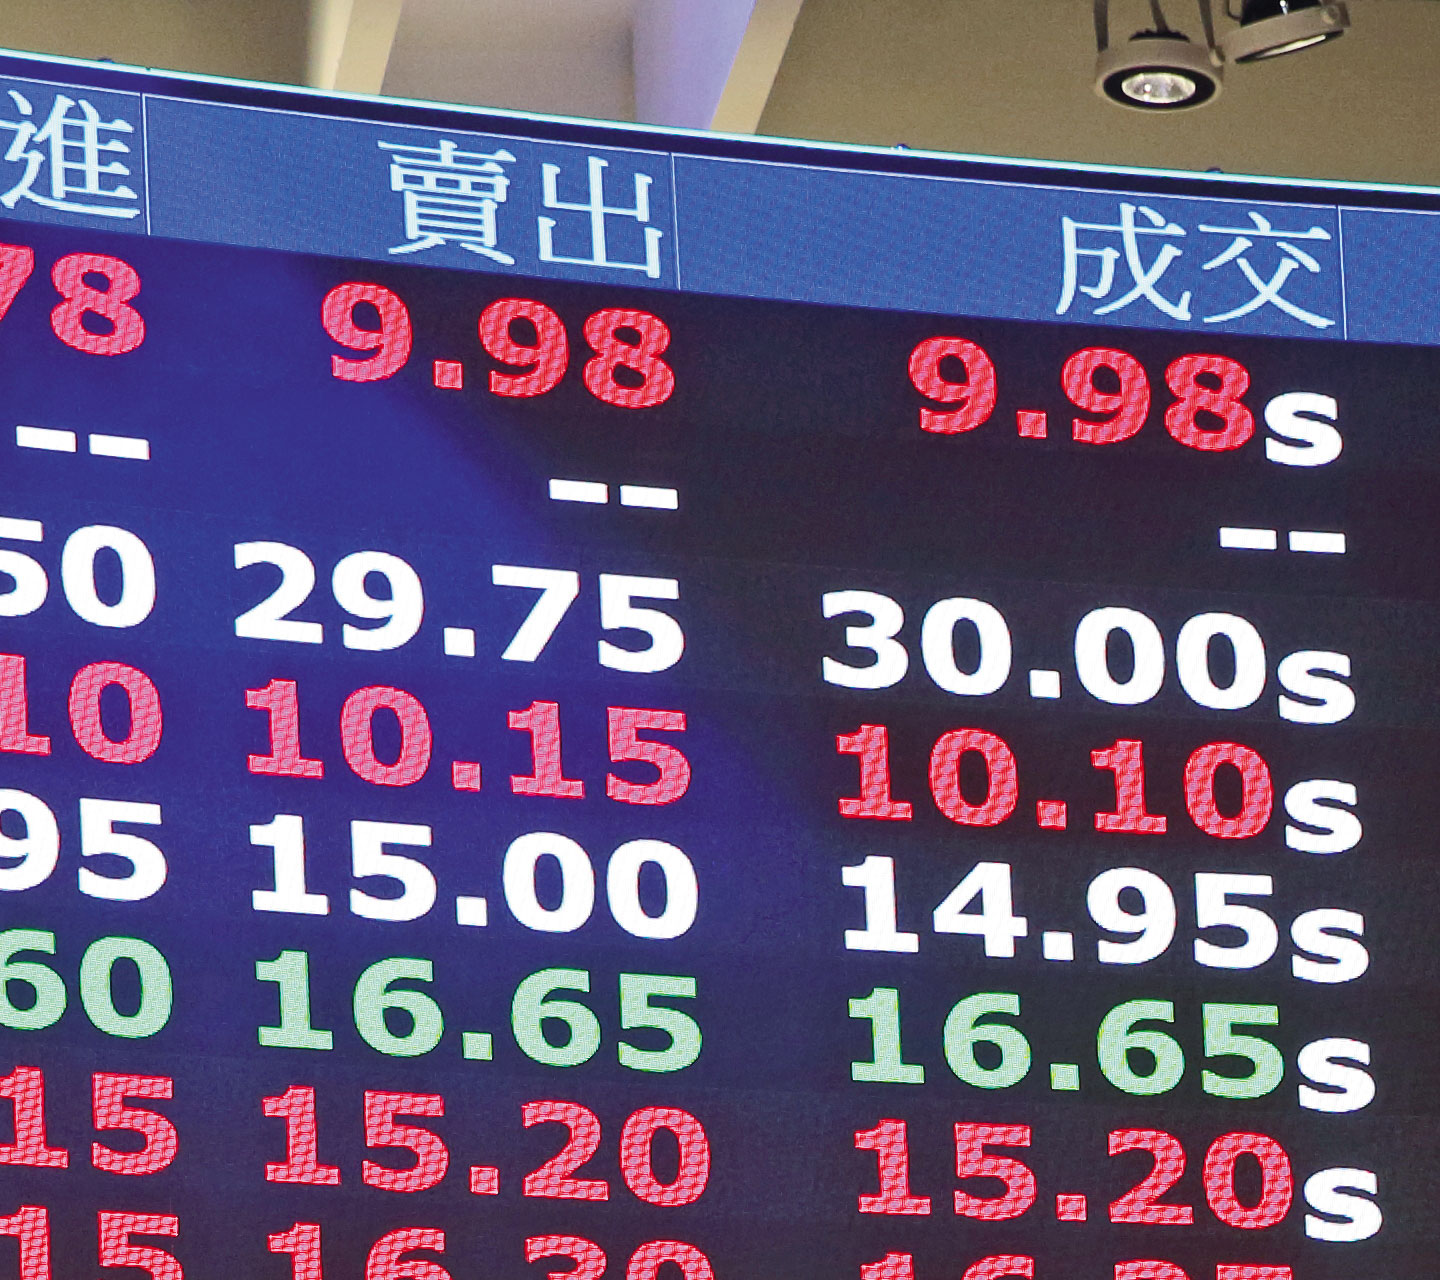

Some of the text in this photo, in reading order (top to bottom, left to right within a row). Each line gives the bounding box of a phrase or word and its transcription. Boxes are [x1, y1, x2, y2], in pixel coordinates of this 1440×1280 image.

[374, 138, 668, 278] 賣出
[1056, 196, 1335, 326] 成交
[321, 282, 675, 409] 9.98
[908, 336, 1342, 466] 9.98s
[234, 541, 684, 673] 29.75
[823, 590, 1355, 724] 30.00s
[245, 678, 691, 806] 10.15
[835, 724, 1362, 854] 10.10s
[250, 815, 698, 939] 15.00
[842, 856, 1369, 983] 14.95s
[256, 950, 702, 1072] 16.65
[849, 988, 1375, 1112] 16.65s
[261, 1085, 710, 1207] 15.20
[854, 1118, 1382, 1242] 15.20s
